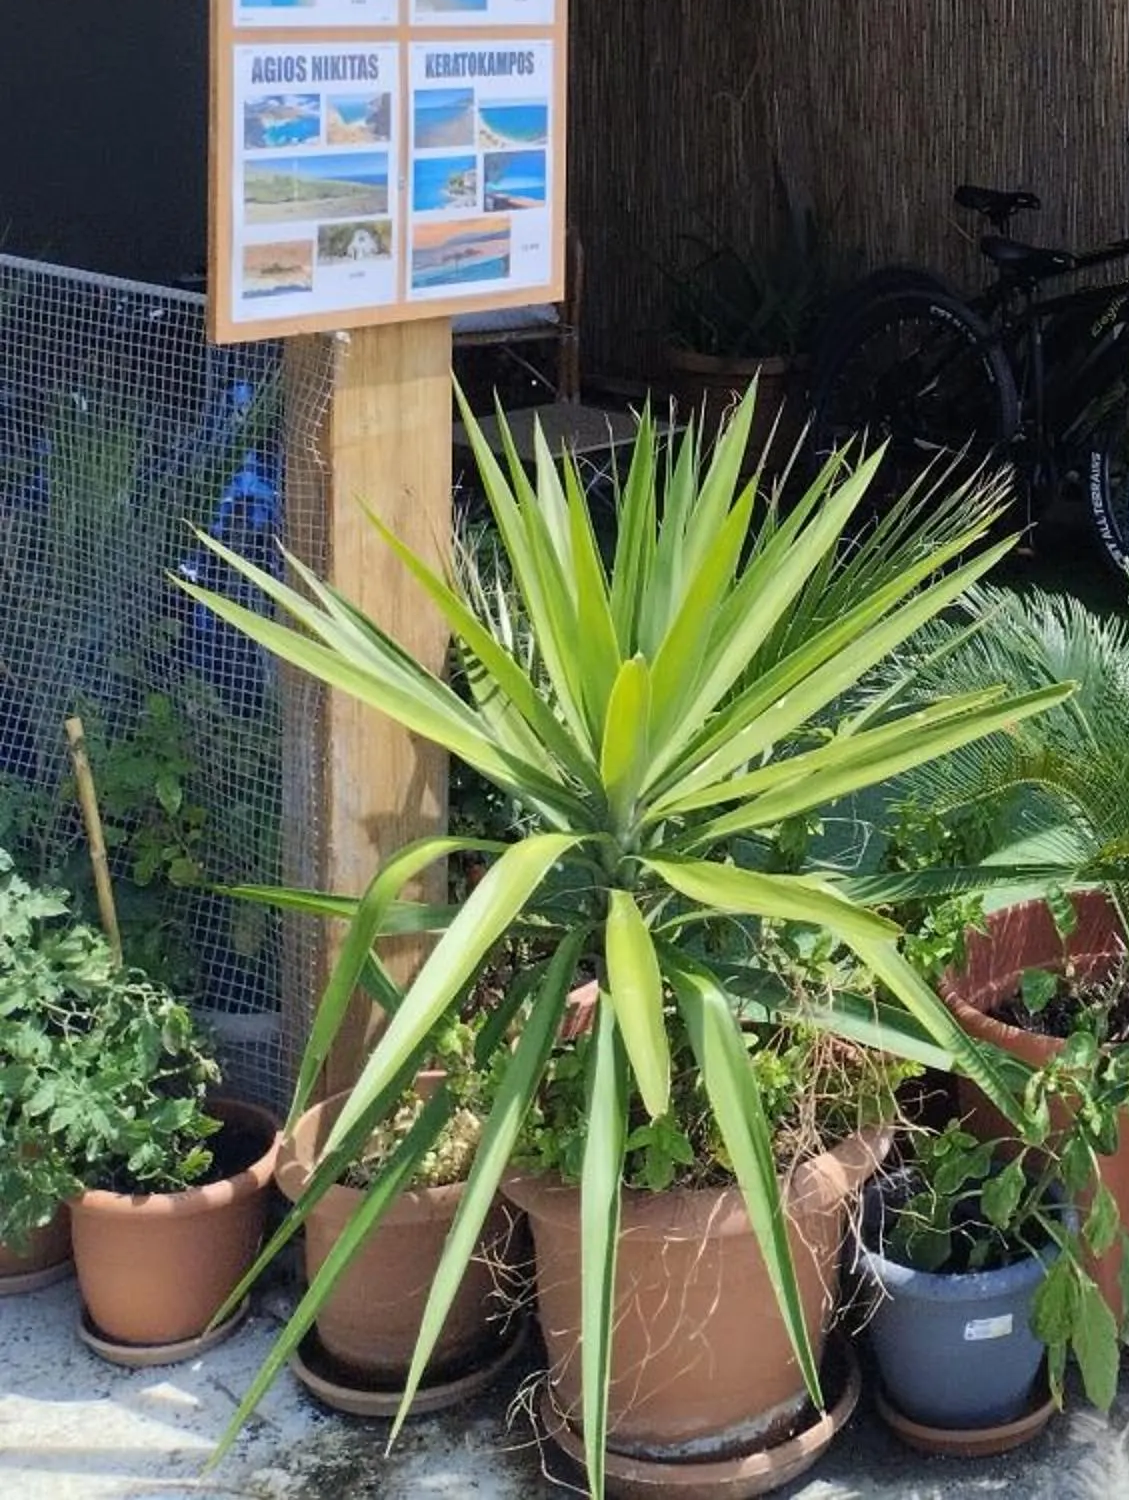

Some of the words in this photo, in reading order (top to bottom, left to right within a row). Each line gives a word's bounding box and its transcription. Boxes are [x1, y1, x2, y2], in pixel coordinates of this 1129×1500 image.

[251, 53, 308, 84] AGIOS
[311, 52, 379, 81] NIKITAS
[425, 50, 535, 80] KERATOKAMPOS
